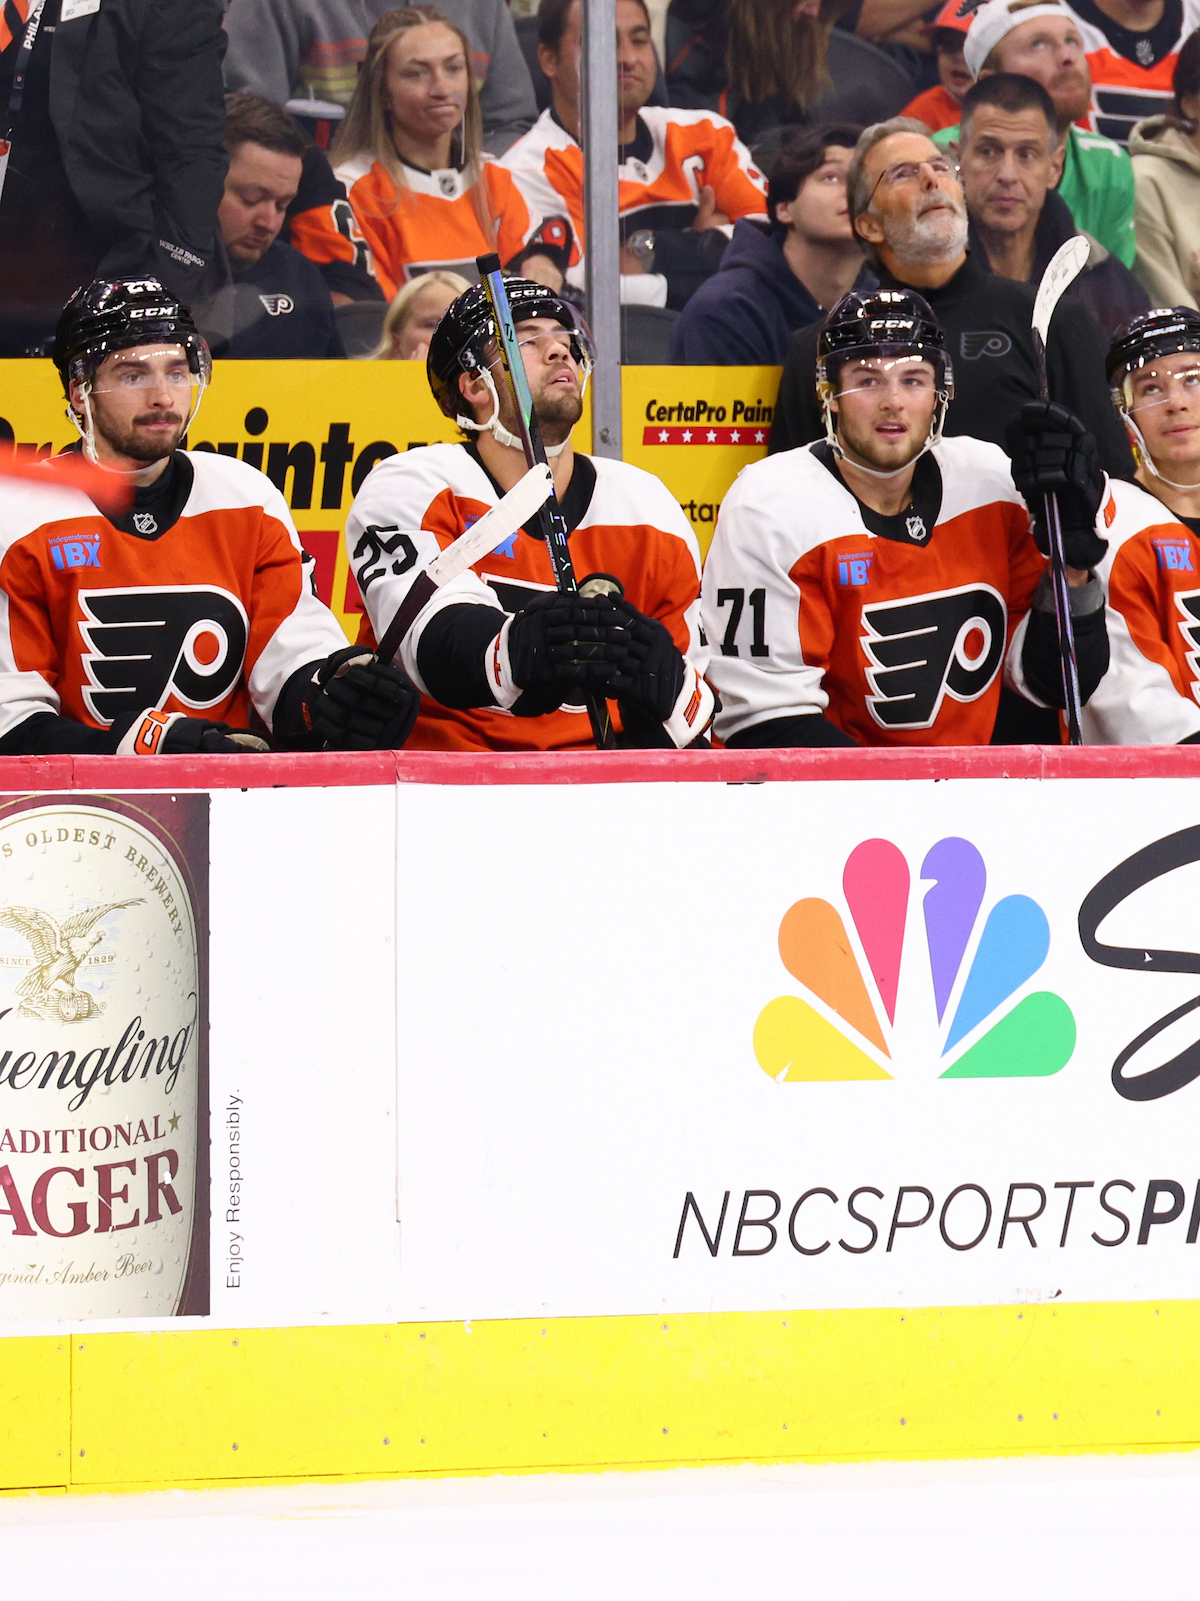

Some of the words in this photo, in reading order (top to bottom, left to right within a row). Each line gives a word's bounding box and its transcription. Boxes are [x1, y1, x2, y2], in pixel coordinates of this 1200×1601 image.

[160, 240, 184, 256] WELLS
[510, 289, 548, 298] CCM
[130, 307, 175, 319] CCM
[870, 320, 914, 329] CCM
[645, 399, 726, 423] CertaPro
[732, 399, 775, 423] Pain
[50, 541, 102, 571] IBX
[353, 524, 418, 597] 25
[1154, 546, 1194, 571] IBX
[716, 588, 769, 658] 71
[25, 828, 117, 851] OLDEST
[124, 845, 183, 936] BREWERY
[0, 957, 32, 967] SINCE
[88, 955, 115, 965] 1829
[0, 1114, 167, 1154] ADITIONAL
[226, 1087, 244, 1223] Responsibly.
[0, 1148, 183, 1239] AGER
[46, 1261, 110, 1286] Amber
[114, 1253, 154, 1279] Beer
[226, 1231, 244, 1289] Enjoy
